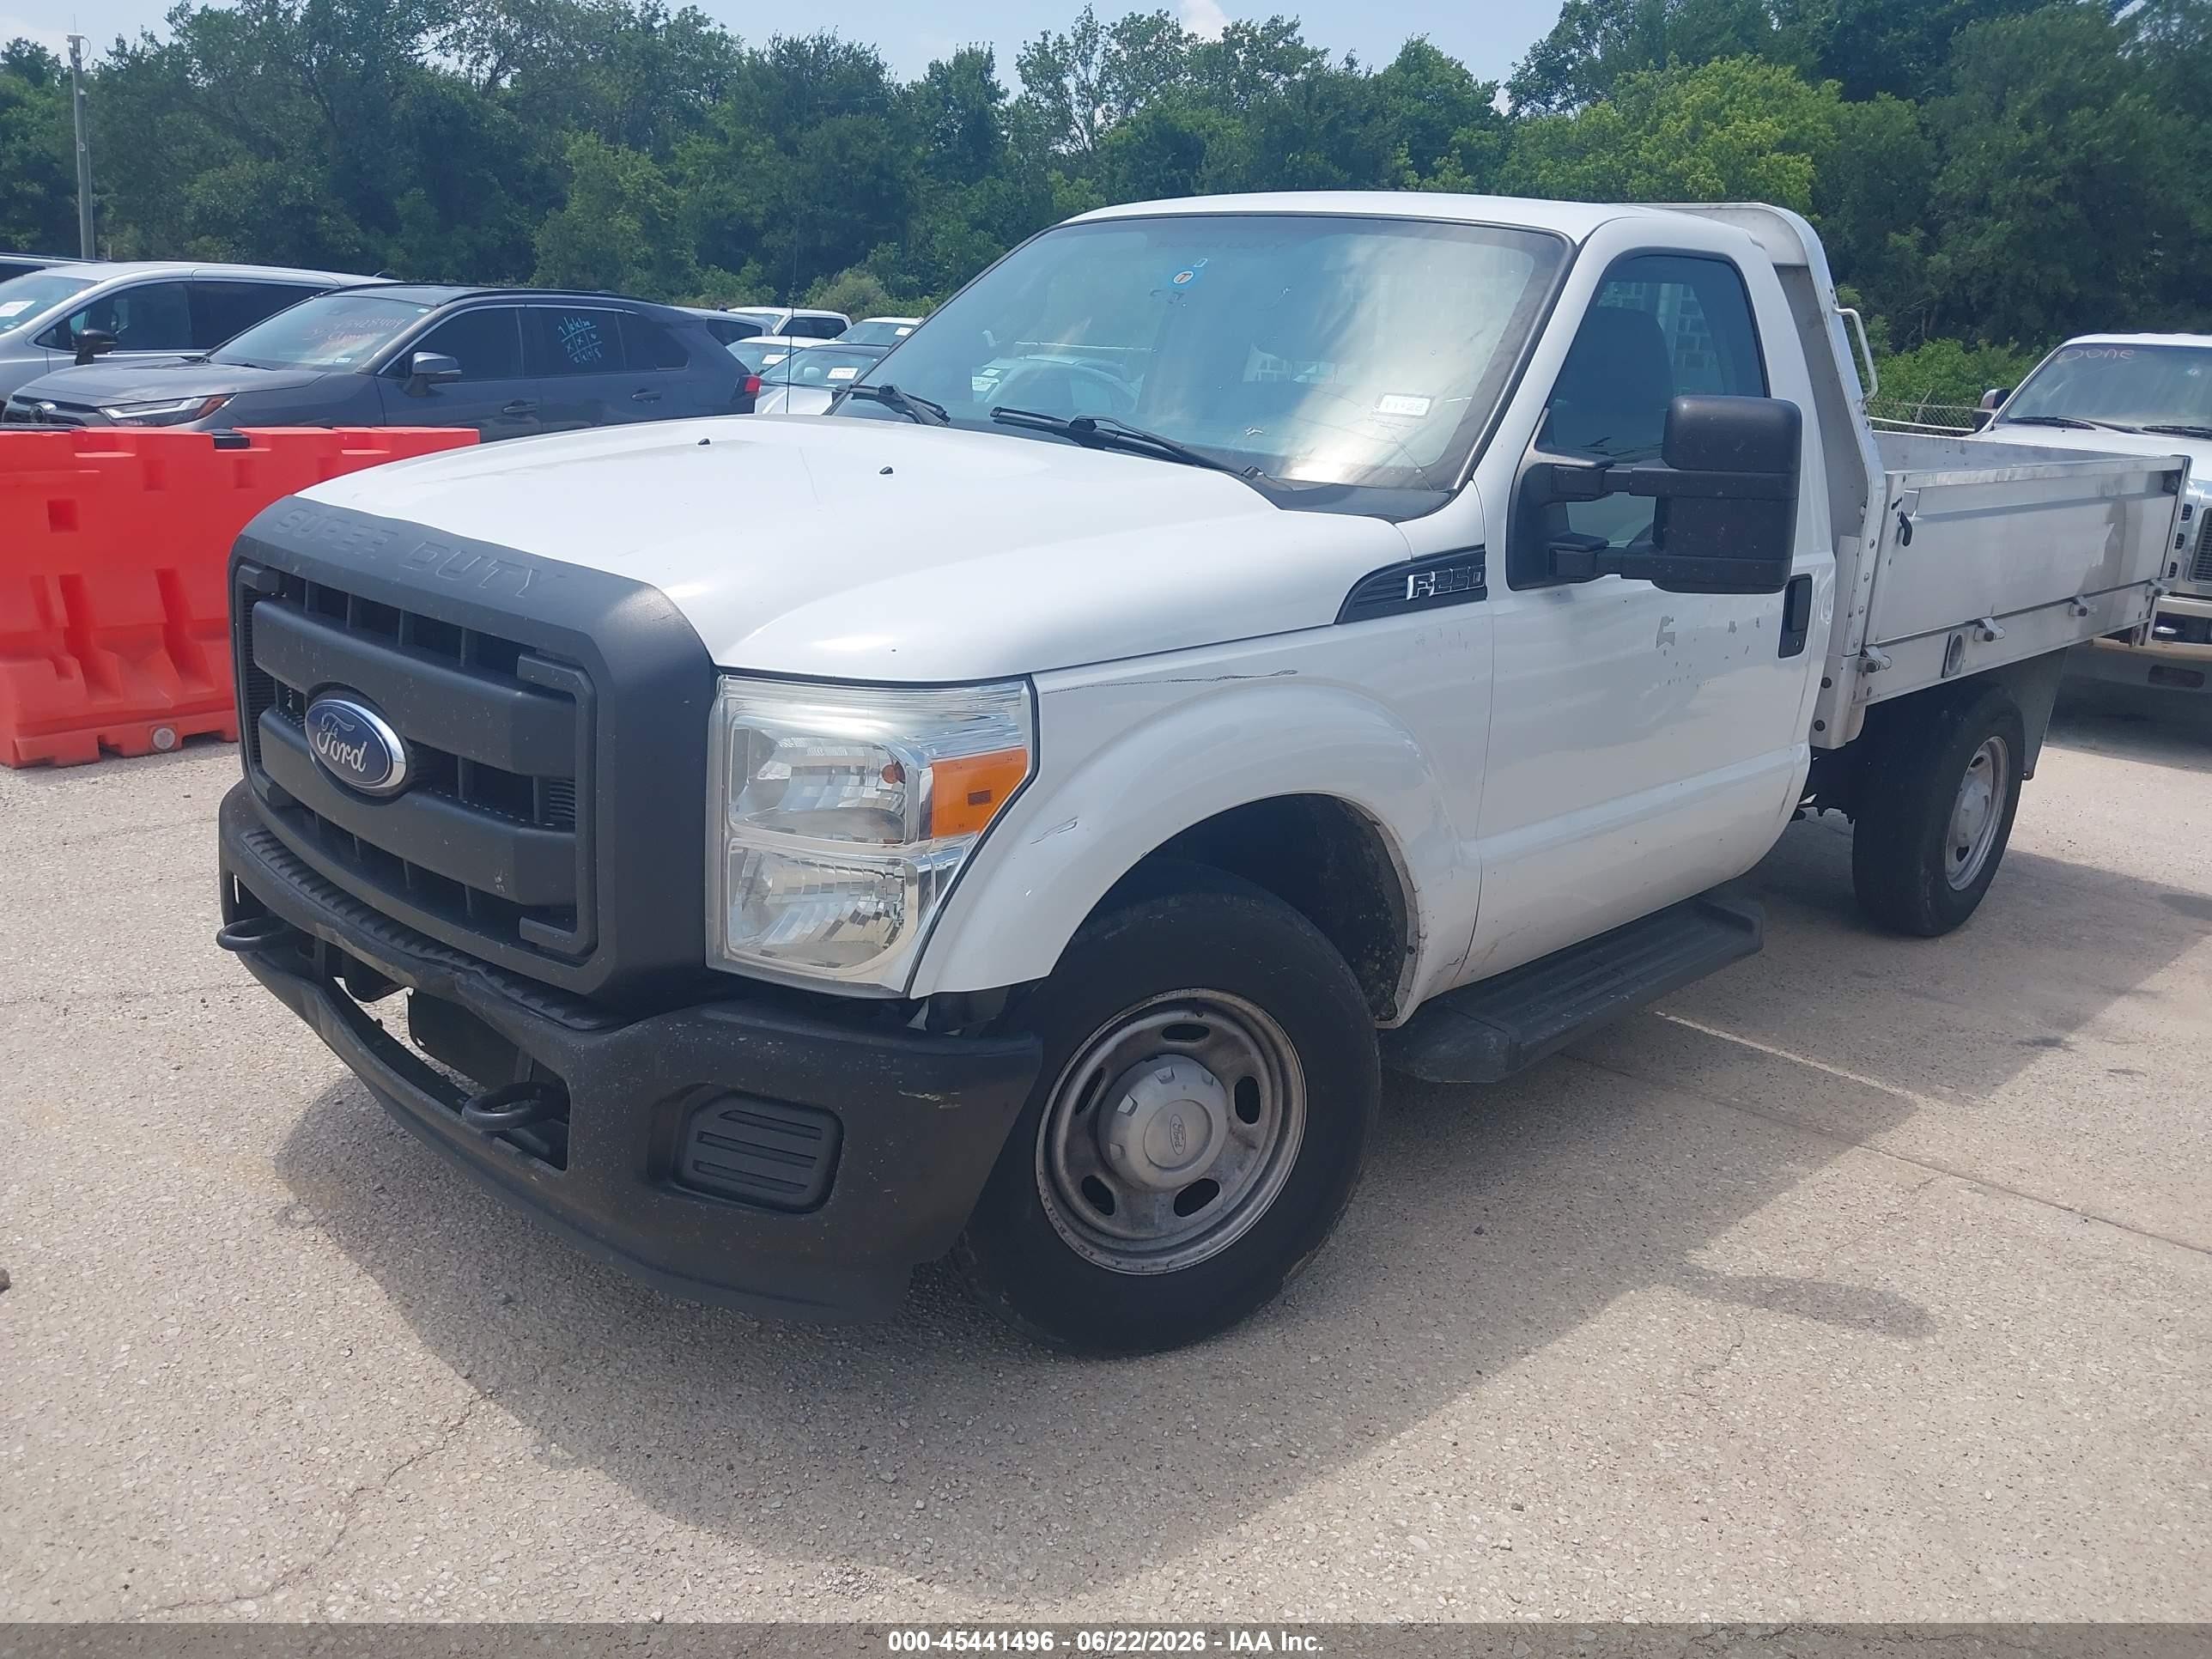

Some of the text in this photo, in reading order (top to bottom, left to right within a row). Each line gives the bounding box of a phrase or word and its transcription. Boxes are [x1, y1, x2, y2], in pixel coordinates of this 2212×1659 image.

[271, 506, 568, 599] SUPER DUTY
[316, 711, 368, 773] Ford
